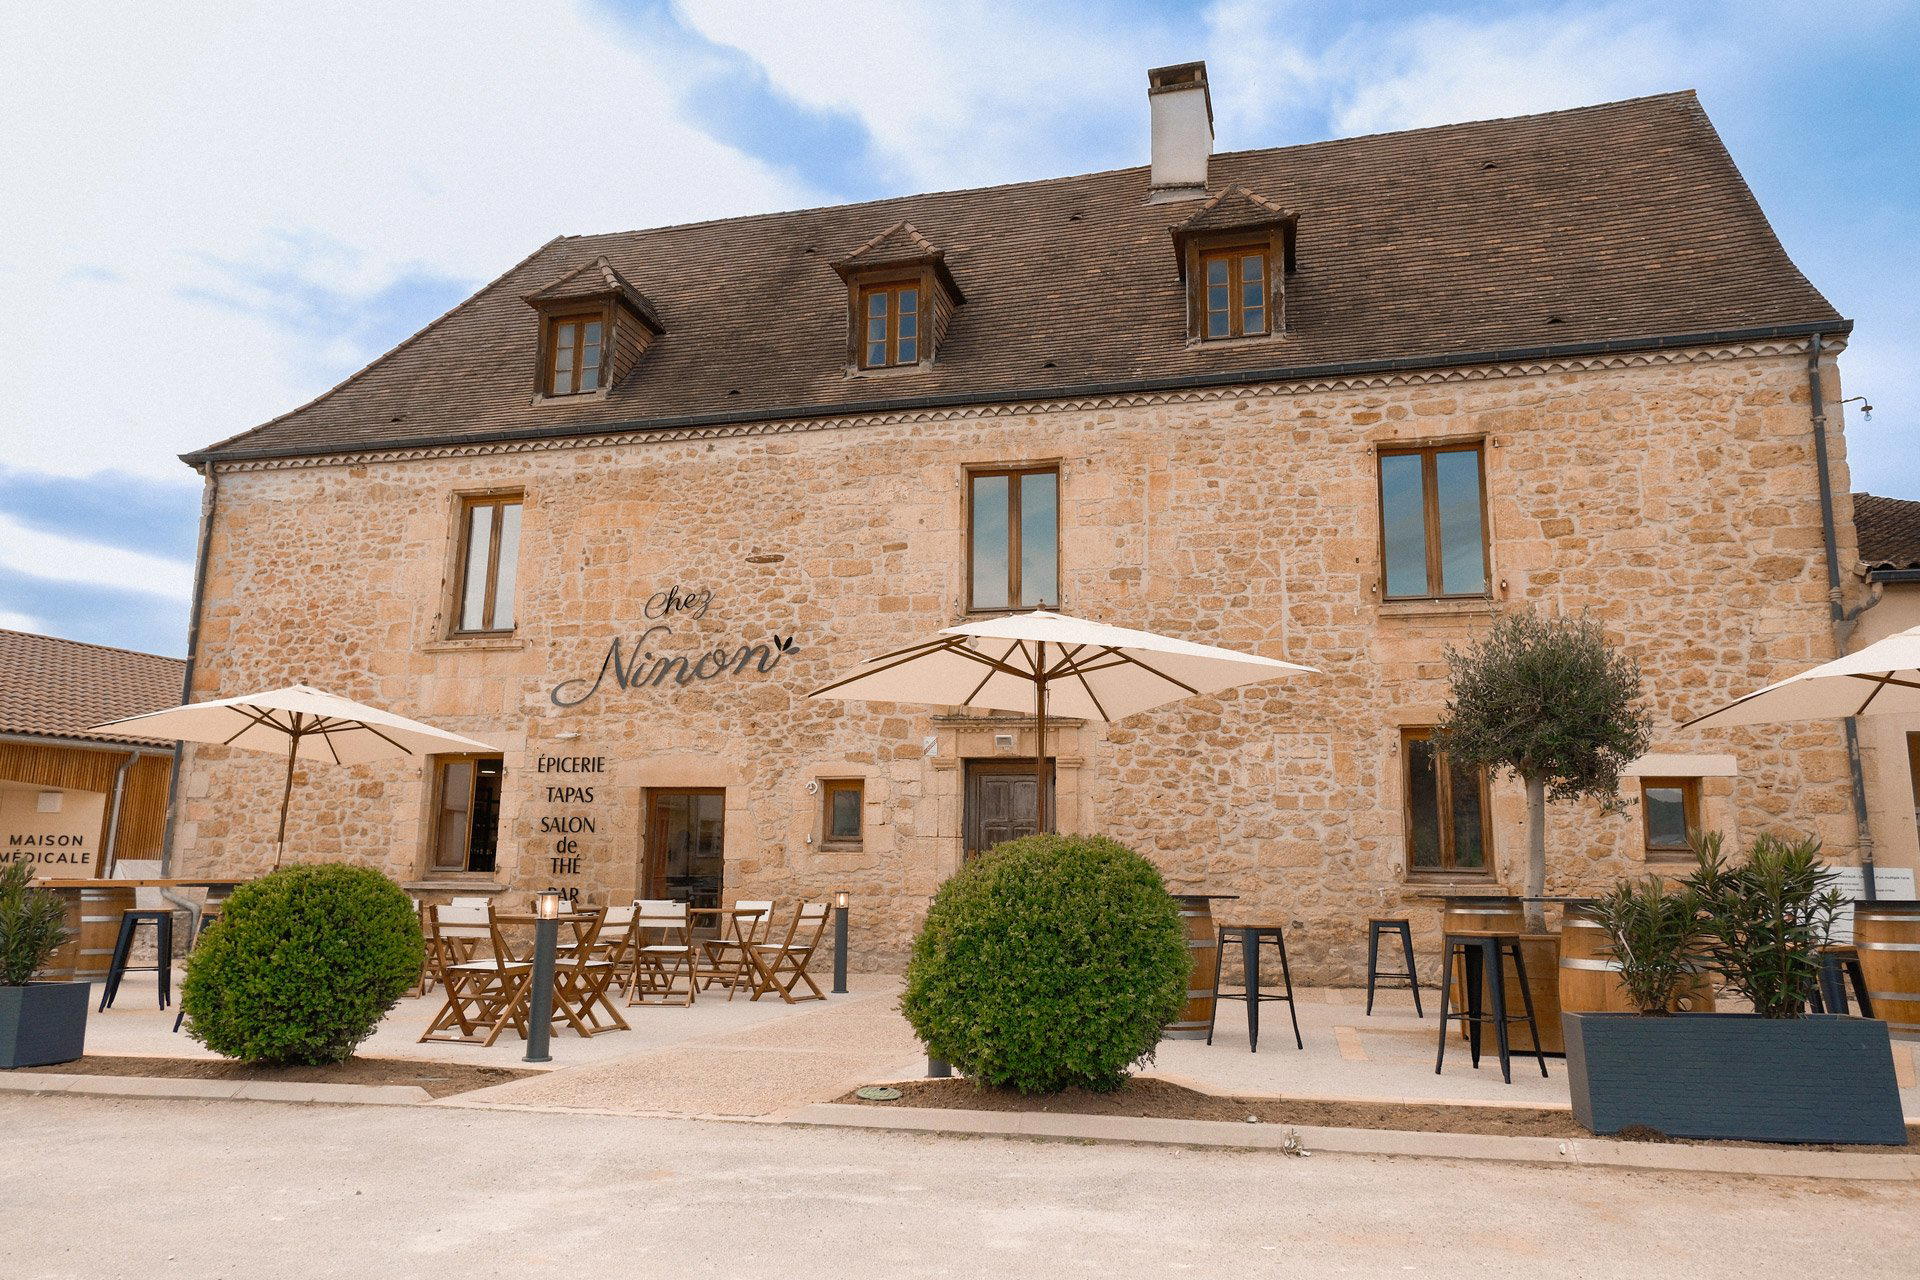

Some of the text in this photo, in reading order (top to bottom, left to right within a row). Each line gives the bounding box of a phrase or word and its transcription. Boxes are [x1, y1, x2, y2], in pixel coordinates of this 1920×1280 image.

[644, 584, 717, 620] Chez
[551, 625, 783, 708] Ninon
[537, 753, 605, 773] ÉPICERIE
[546, 786, 594, 803] TAPAS
[540, 816, 595, 833] SALON
[9, 834, 83, 846] MAISON
[556, 836, 577, 854] de
[550, 854, 581, 874] THÉ
[548, 886, 579, 904] AR
